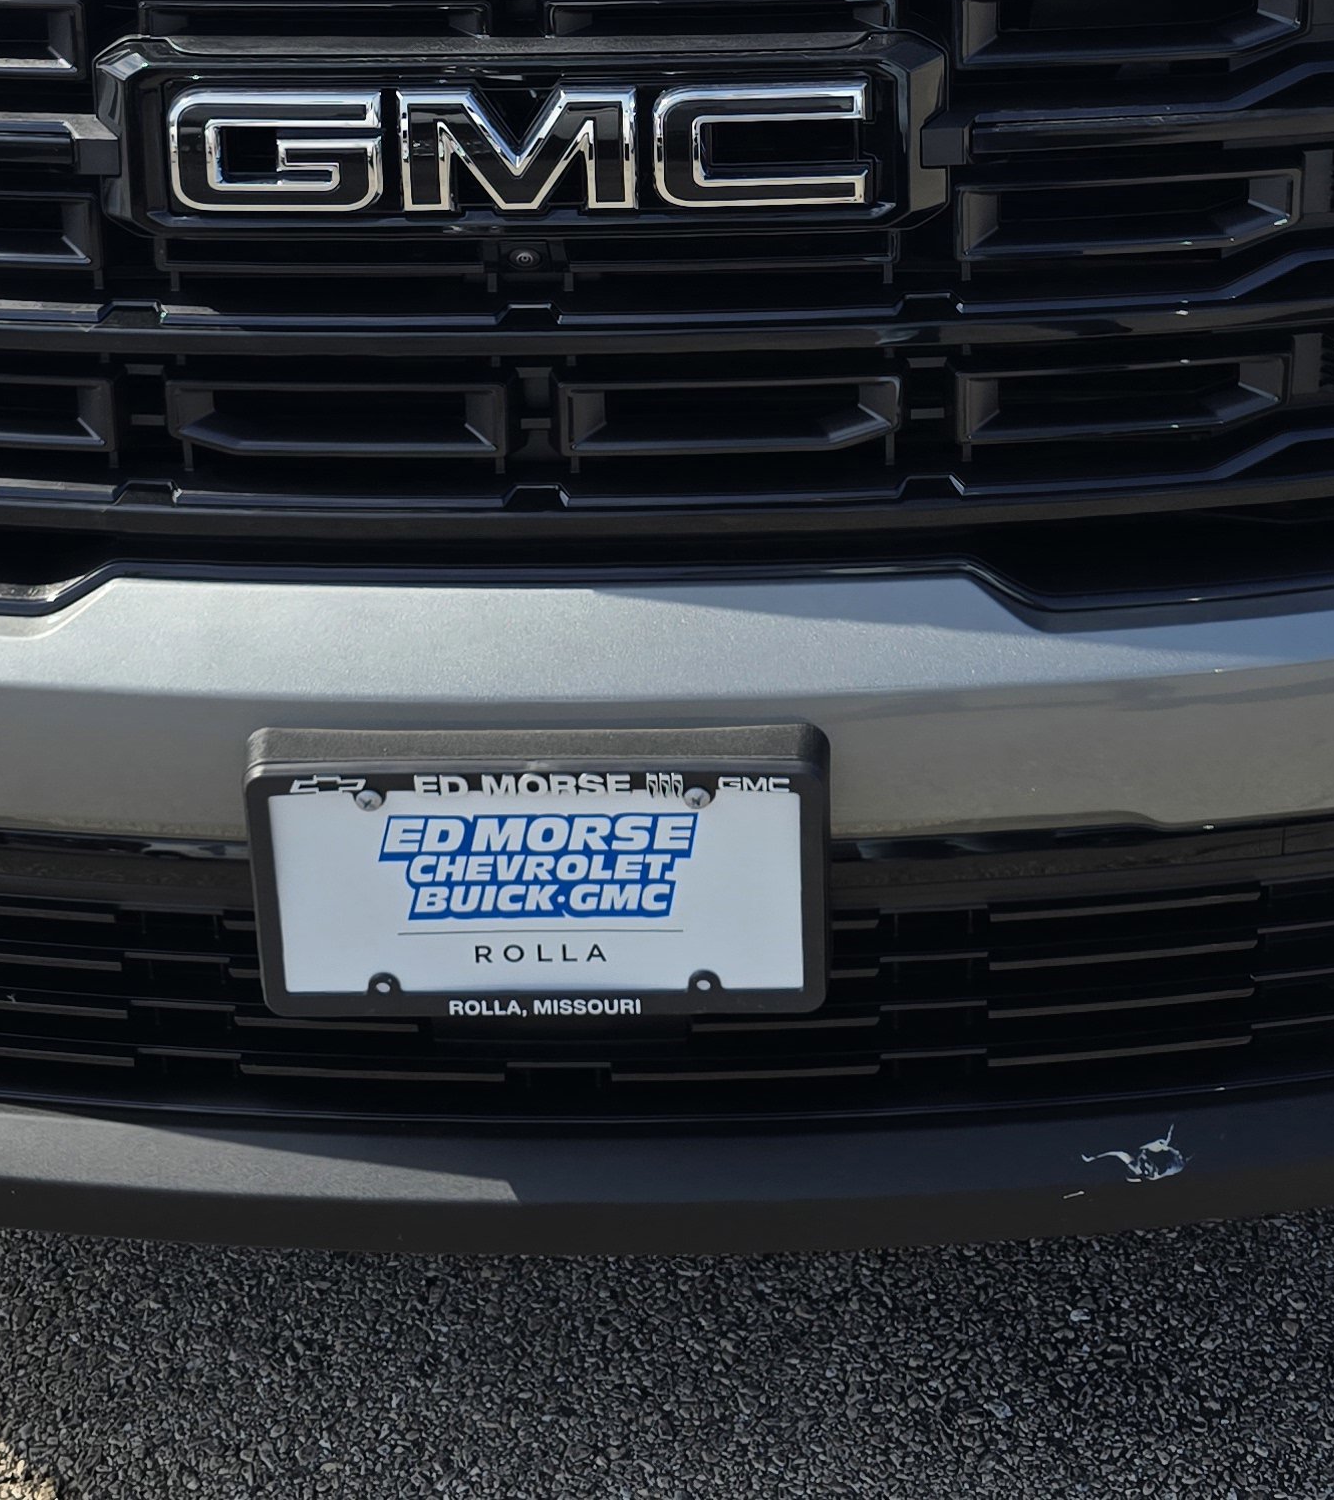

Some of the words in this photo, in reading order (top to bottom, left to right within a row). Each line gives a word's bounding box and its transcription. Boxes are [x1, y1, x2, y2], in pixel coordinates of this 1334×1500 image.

[169, 84, 868, 212] GMC
[413, 775, 467, 797] ED
[480, 773, 631, 797] MORSE
[717, 776, 791, 793] GMC
[382, 816, 466, 854] ED
[470, 813, 697, 853] MORSE
[408, 854, 671, 883] CHEVROLET
[474, 943, 608, 964] ROLLA
[448, 1000, 528, 1018] ROLLA,
[532, 998, 642, 1016] MISSOURI
